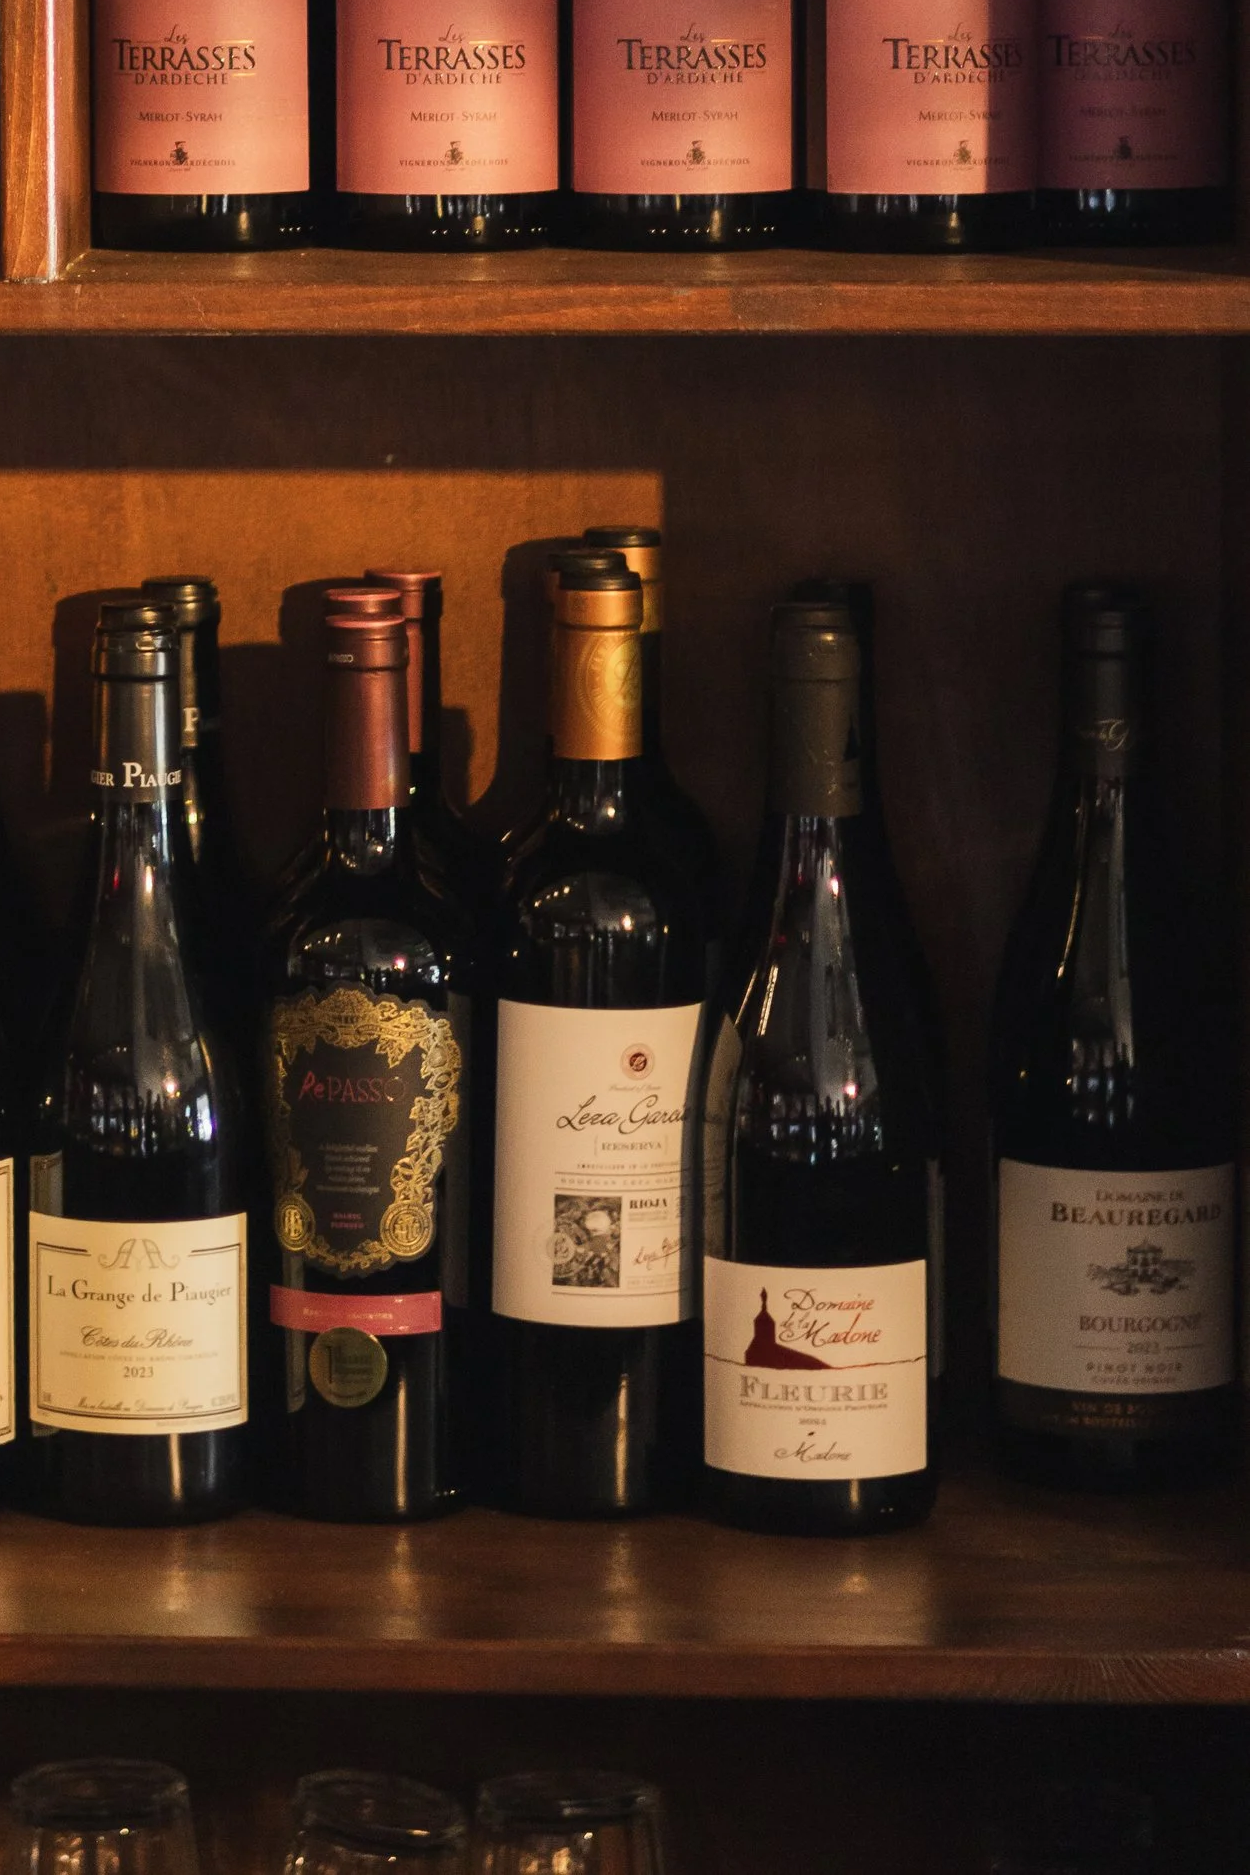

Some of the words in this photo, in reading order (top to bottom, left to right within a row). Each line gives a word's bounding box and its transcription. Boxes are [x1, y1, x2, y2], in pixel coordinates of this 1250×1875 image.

[438, 23, 466, 43] Les
[112, 39, 256, 70] TERRASSES
[377, 39, 526, 70] TERRASSES
[617, 38, 766, 70] TERRASSES
[882, 38, 1022, 69] TERRASSES
[1048, 35, 1197, 66] TERRASSES
[556, 1095, 622, 1131] Leza
[601, 1142, 662, 1151] RESERVA
[630, 1198, 668, 1209] RIOJA
[1050, 1202, 1221, 1226] BEAUREGARD
[47, 1275, 66, 1297] La
[71, 1279, 134, 1309] Grange
[142, 1283, 162, 1302] de
[169, 1281, 232, 1306] Piaugier
[784, 1288, 875, 1311] Domaine
[80, 1325, 120, 1348] Côtes
[122, 1335, 139, 1348] du
[141, 1327, 193, 1349] Rhône
[778, 1313, 883, 1348] Madone
[1079, 1313, 1202, 1333] BOURGOGNE
[123, 1366, 154, 1378] 2023
[740, 1374, 889, 1402] FLEURIE
